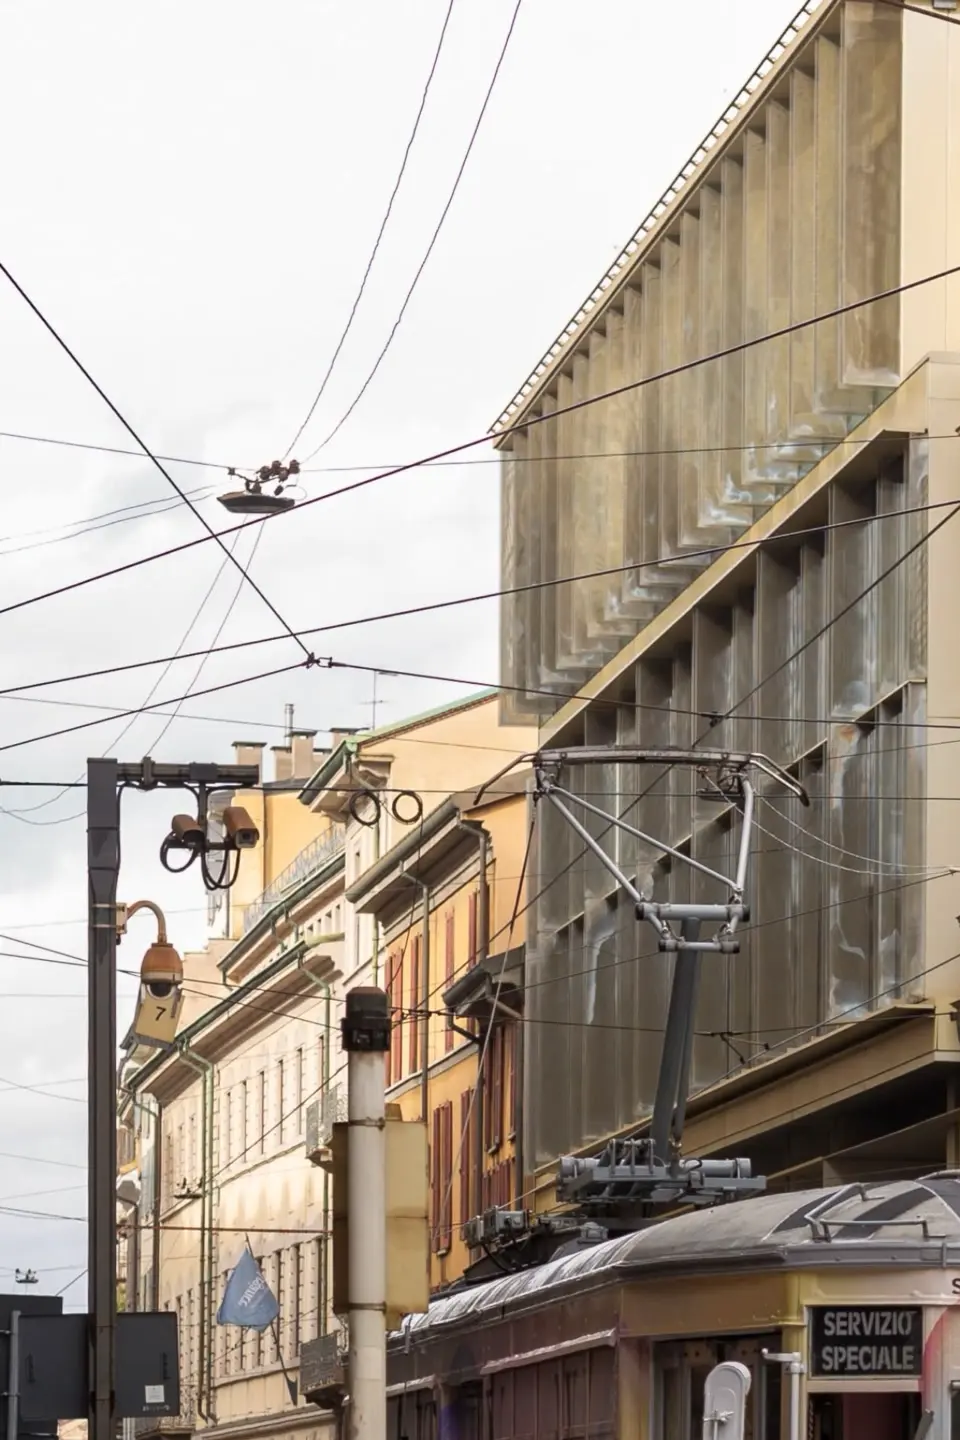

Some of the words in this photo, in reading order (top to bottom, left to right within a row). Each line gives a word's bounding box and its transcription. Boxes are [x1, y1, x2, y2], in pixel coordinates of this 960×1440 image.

[155, 1005, 167, 1022] 7
[823, 1310, 915, 1337] SERVIZIO
[821, 1345, 915, 1372] SPECIALE
